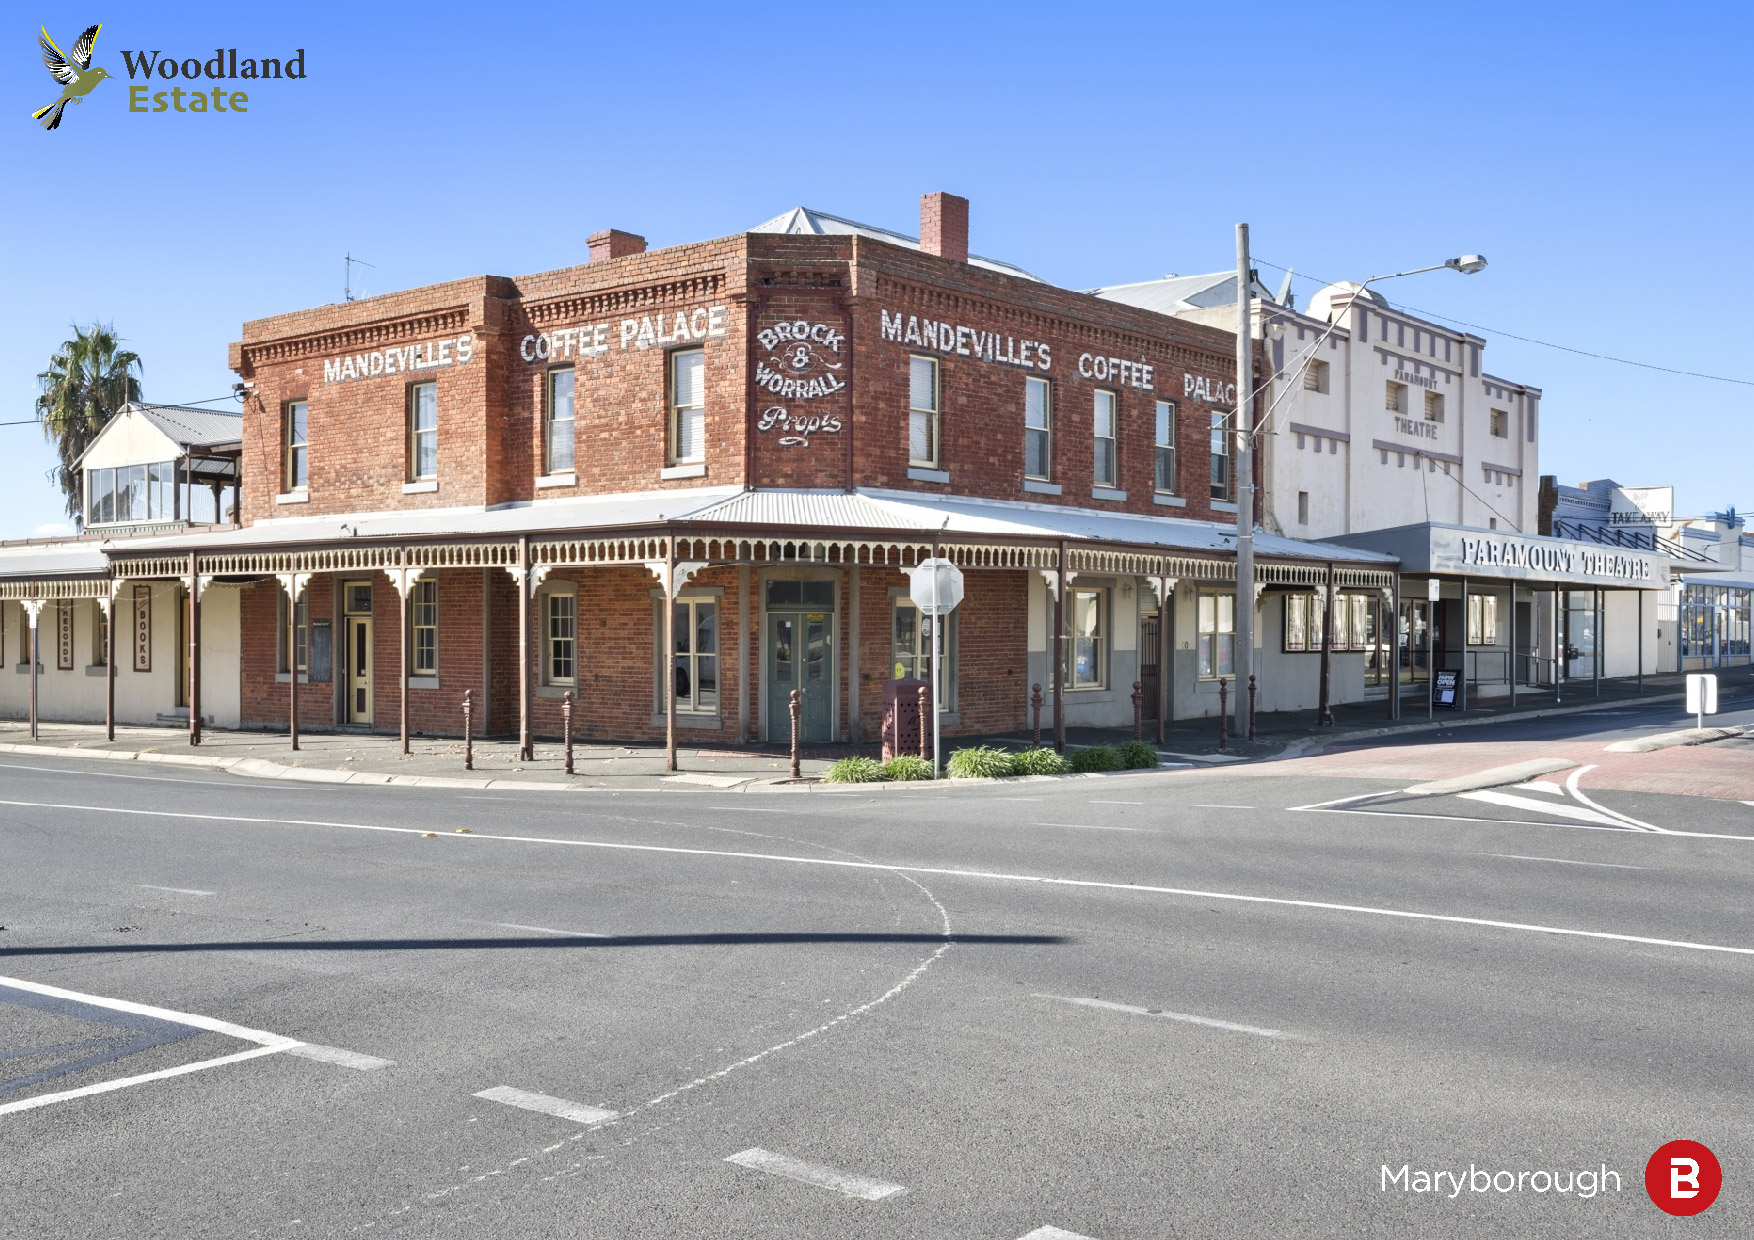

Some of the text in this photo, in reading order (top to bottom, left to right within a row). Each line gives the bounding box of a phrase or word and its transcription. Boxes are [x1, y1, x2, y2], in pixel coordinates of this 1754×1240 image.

[323, 305, 727, 383] MANDEVILLE'S COFFEE PALACE
[756, 321, 845, 353] BROCK
[881, 309, 1238, 406] MANDEVILLE'S COFFEE PALAC
[755, 361, 846, 398] WORRALL
[1394, 369, 1438, 390] PARAMOUNT
[1394, 416, 1438, 440] THEATRE
[1611, 511, 1670, 524] TAKE AWAY
[1462, 538, 1652, 581] PARAMOUNT THEATRE
